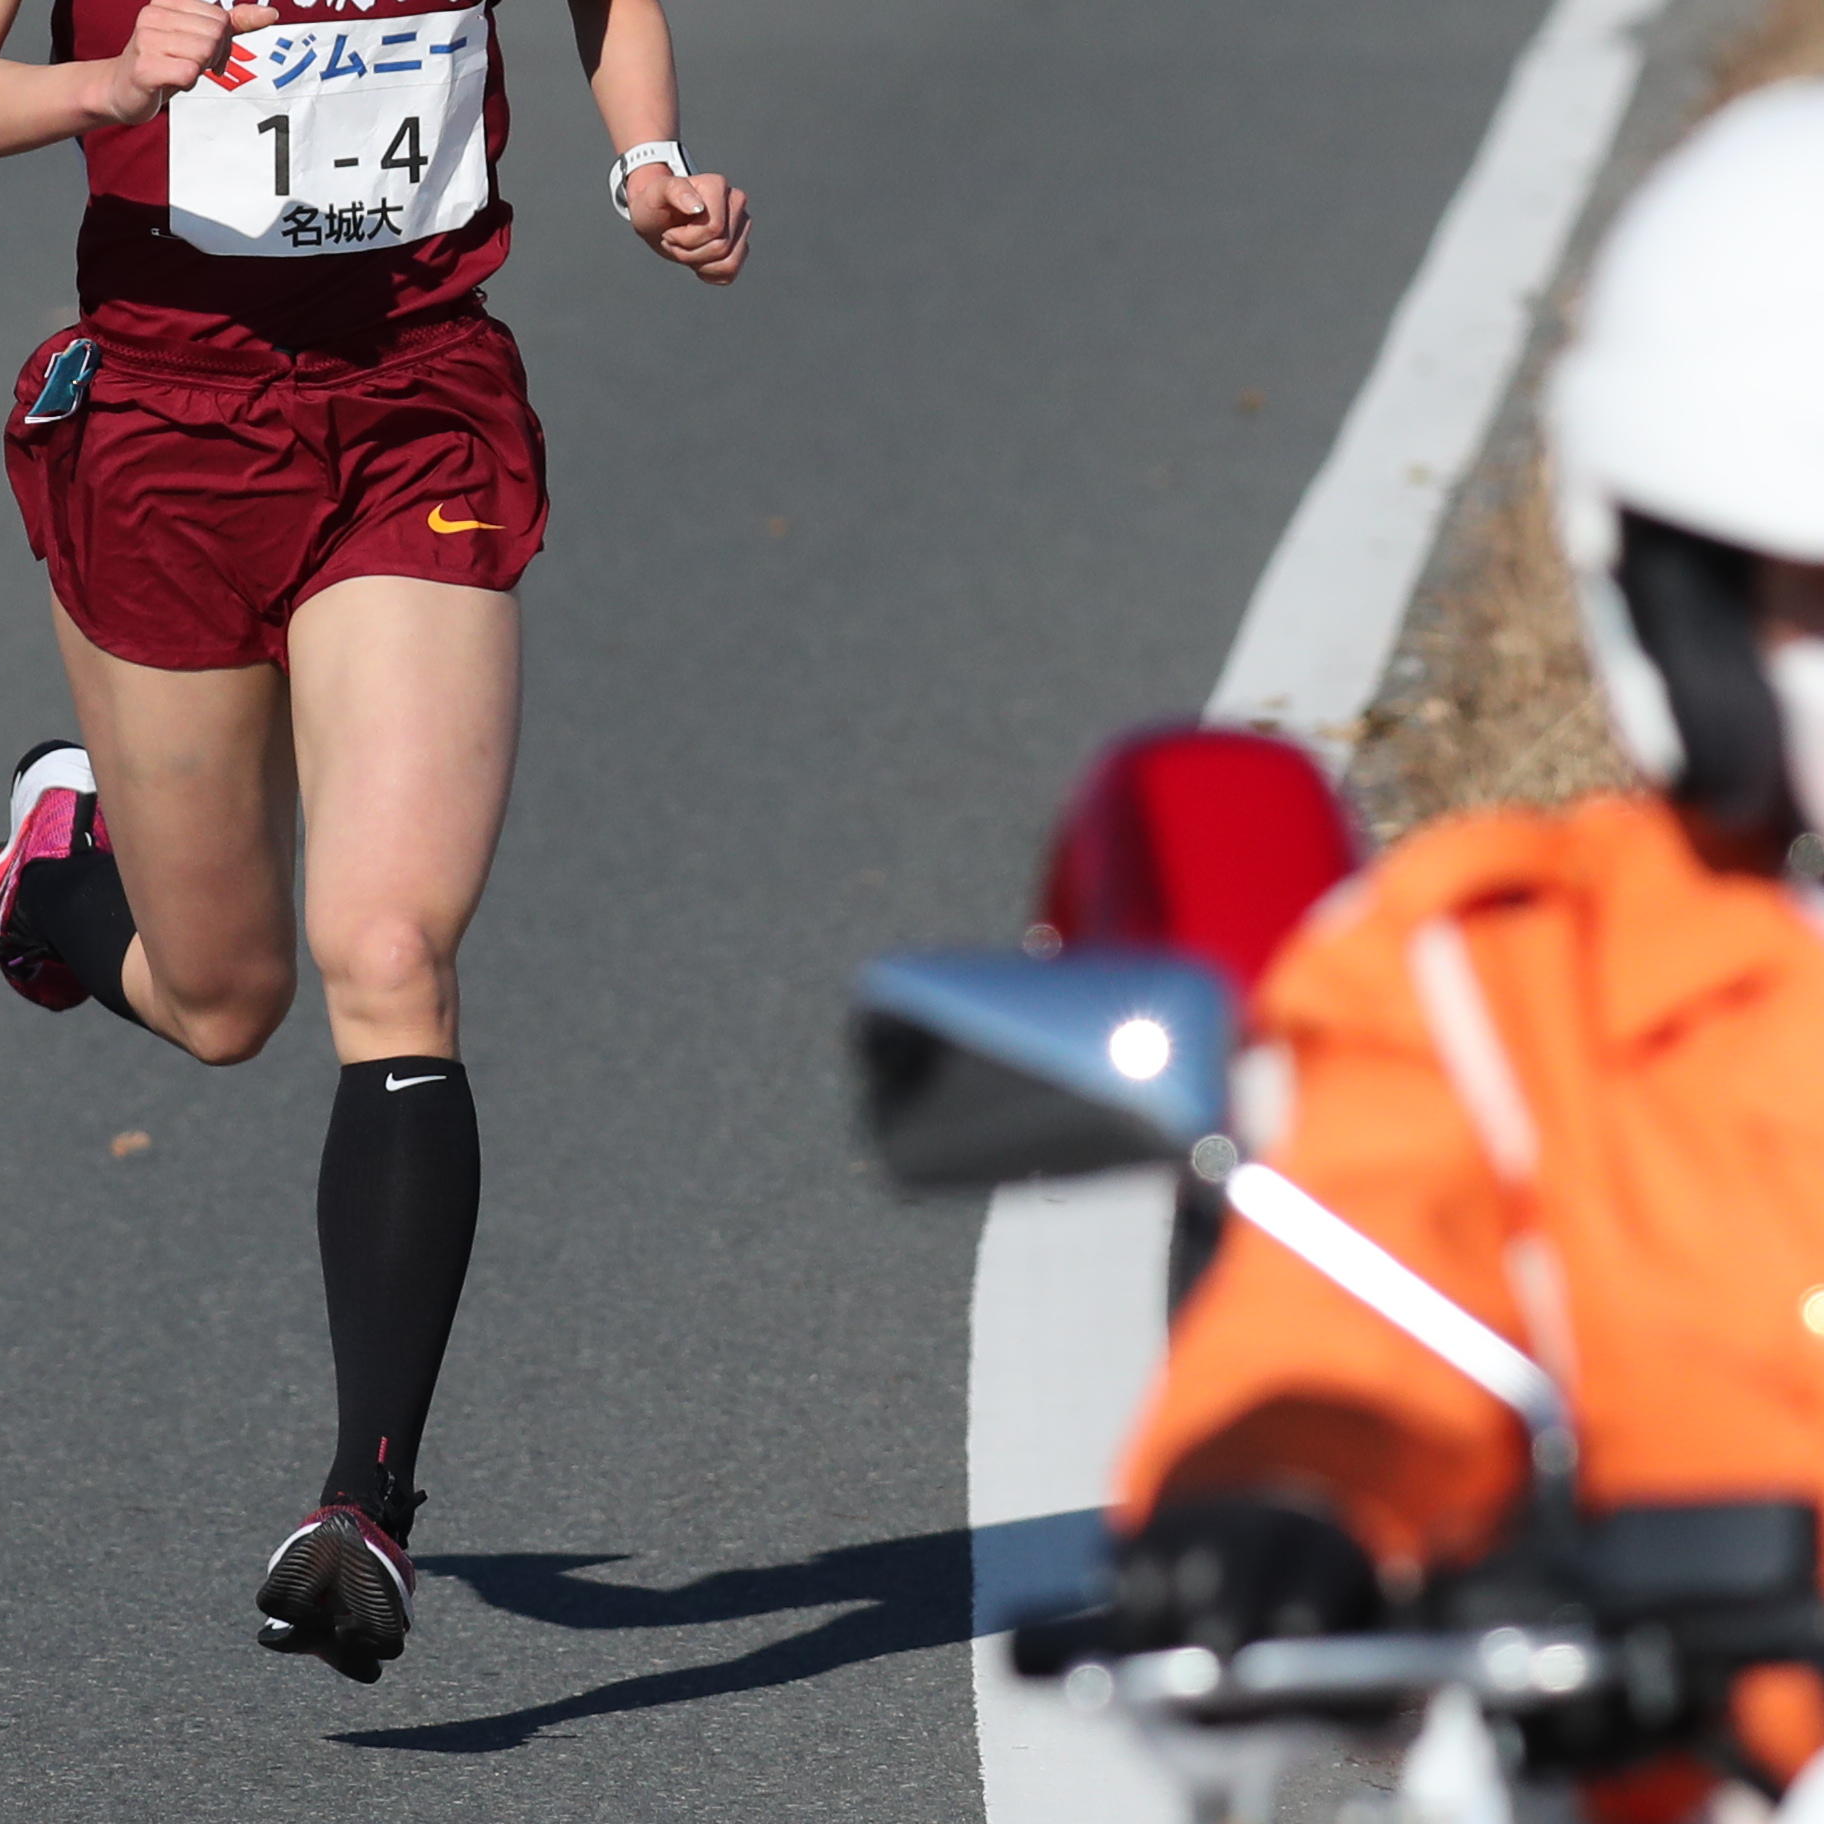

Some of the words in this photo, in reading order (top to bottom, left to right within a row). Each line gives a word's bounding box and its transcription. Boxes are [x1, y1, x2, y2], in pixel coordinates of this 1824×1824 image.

[269, 33, 468, 90] ジムニー
[281, 197, 404, 248] 名城大
